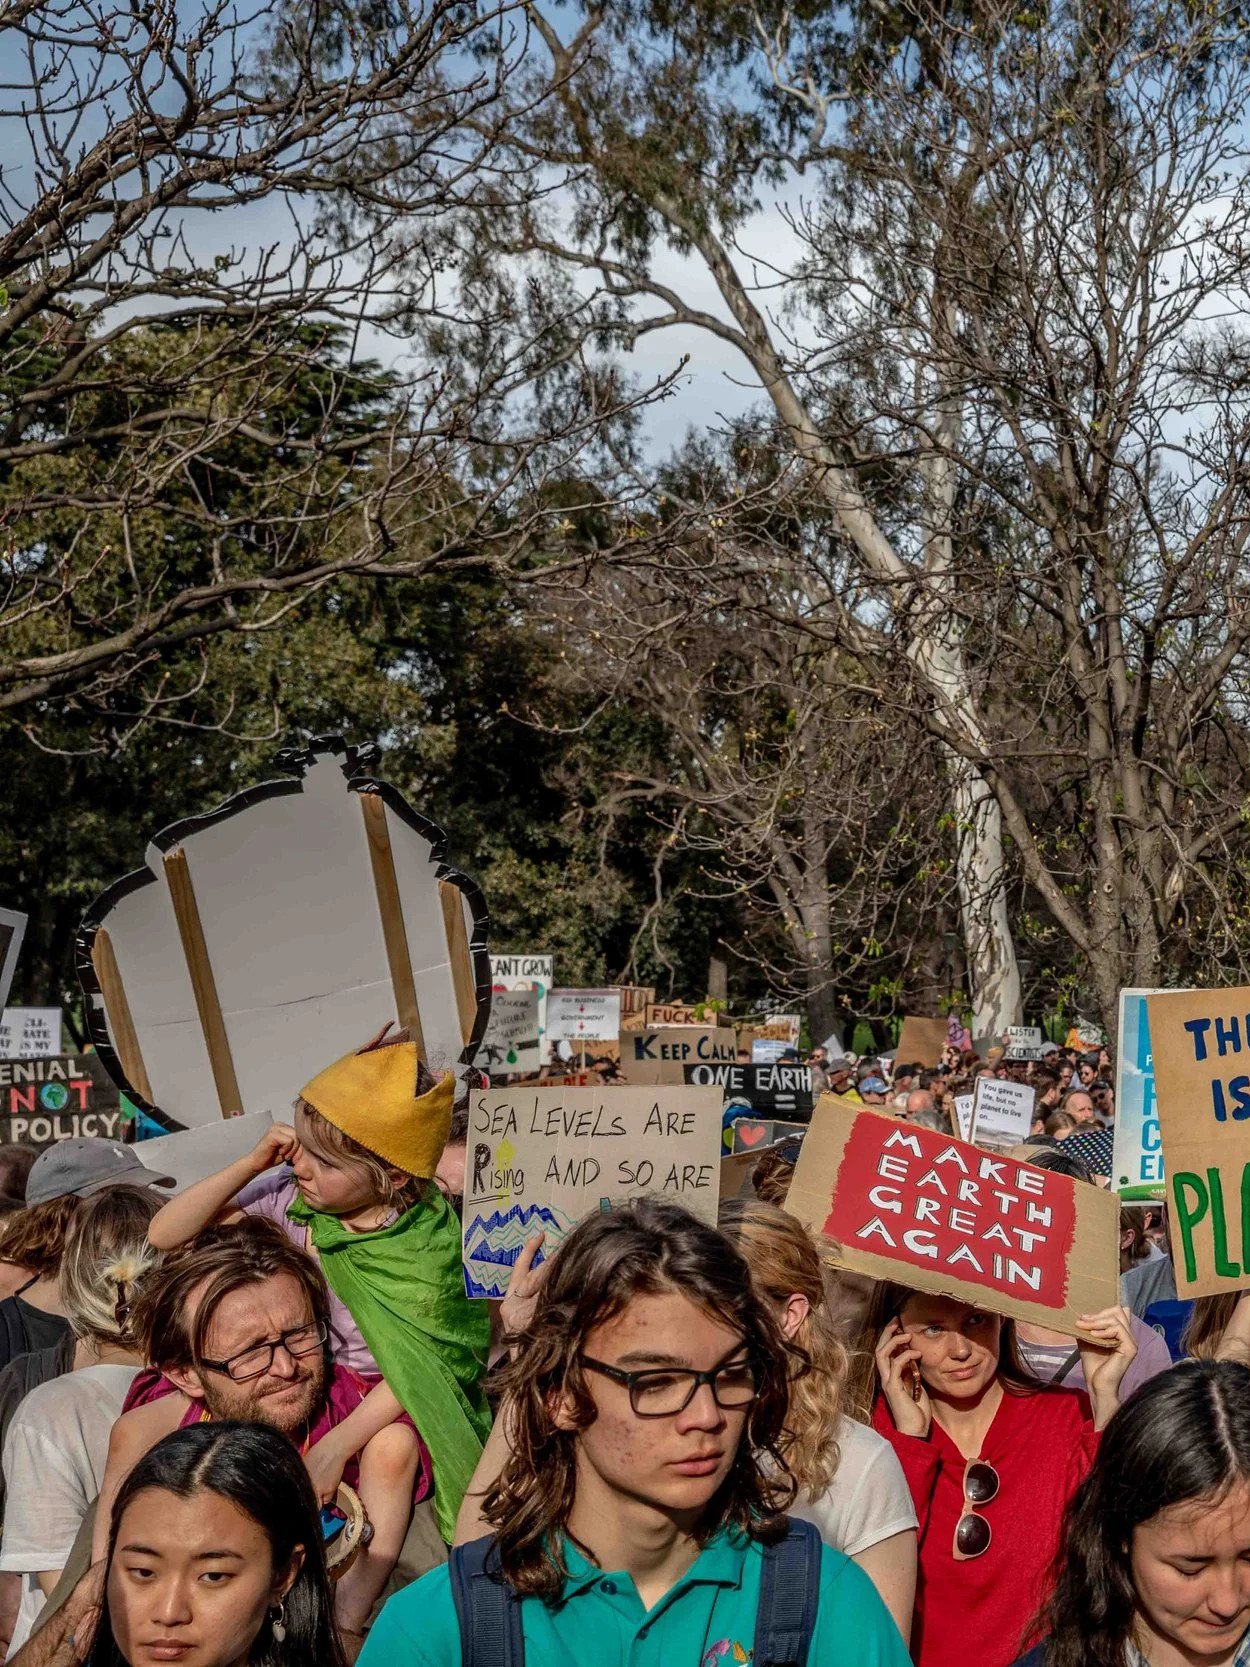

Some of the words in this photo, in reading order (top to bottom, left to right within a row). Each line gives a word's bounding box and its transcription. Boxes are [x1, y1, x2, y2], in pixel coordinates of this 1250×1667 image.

[523, 958, 552, 977] GROW
[652, 1008, 694, 1024] FUCK
[1010, 1028, 1035, 1037] LISTEN
[634, 1034, 691, 1061] KEEP
[697, 1035, 736, 1061] CALM
[0, 1059, 83, 1085] ENIAL
[691, 1065, 744, 1090] ONE
[756, 1065, 812, 1093] EARTH
[982, 1093, 994, 1102] life,
[996, 1096, 1006, 1105] but
[984, 1083, 996, 1092] You
[998, 1088, 1013, 1096] gave
[475, 1098, 517, 1139] SEA
[530, 1096, 626, 1137] LEVELS
[643, 1103, 695, 1136] ARE
[980, 1103, 1001, 1113] planet
[1010, 1110, 1021, 1118] live
[11, 1112, 119, 1143] POLICY
[472, 1143, 524, 1195] Rising
[545, 1155, 600, 1187] AND
[618, 1160, 653, 1186] SO
[663, 1163, 714, 1192] ARE
[883, 1129, 1046, 1196] MAKE
[877, 1153, 1052, 1227] EARTH
[868, 1185, 1047, 1253] GREAT
[856, 1215, 1041, 1291] AGAIN
